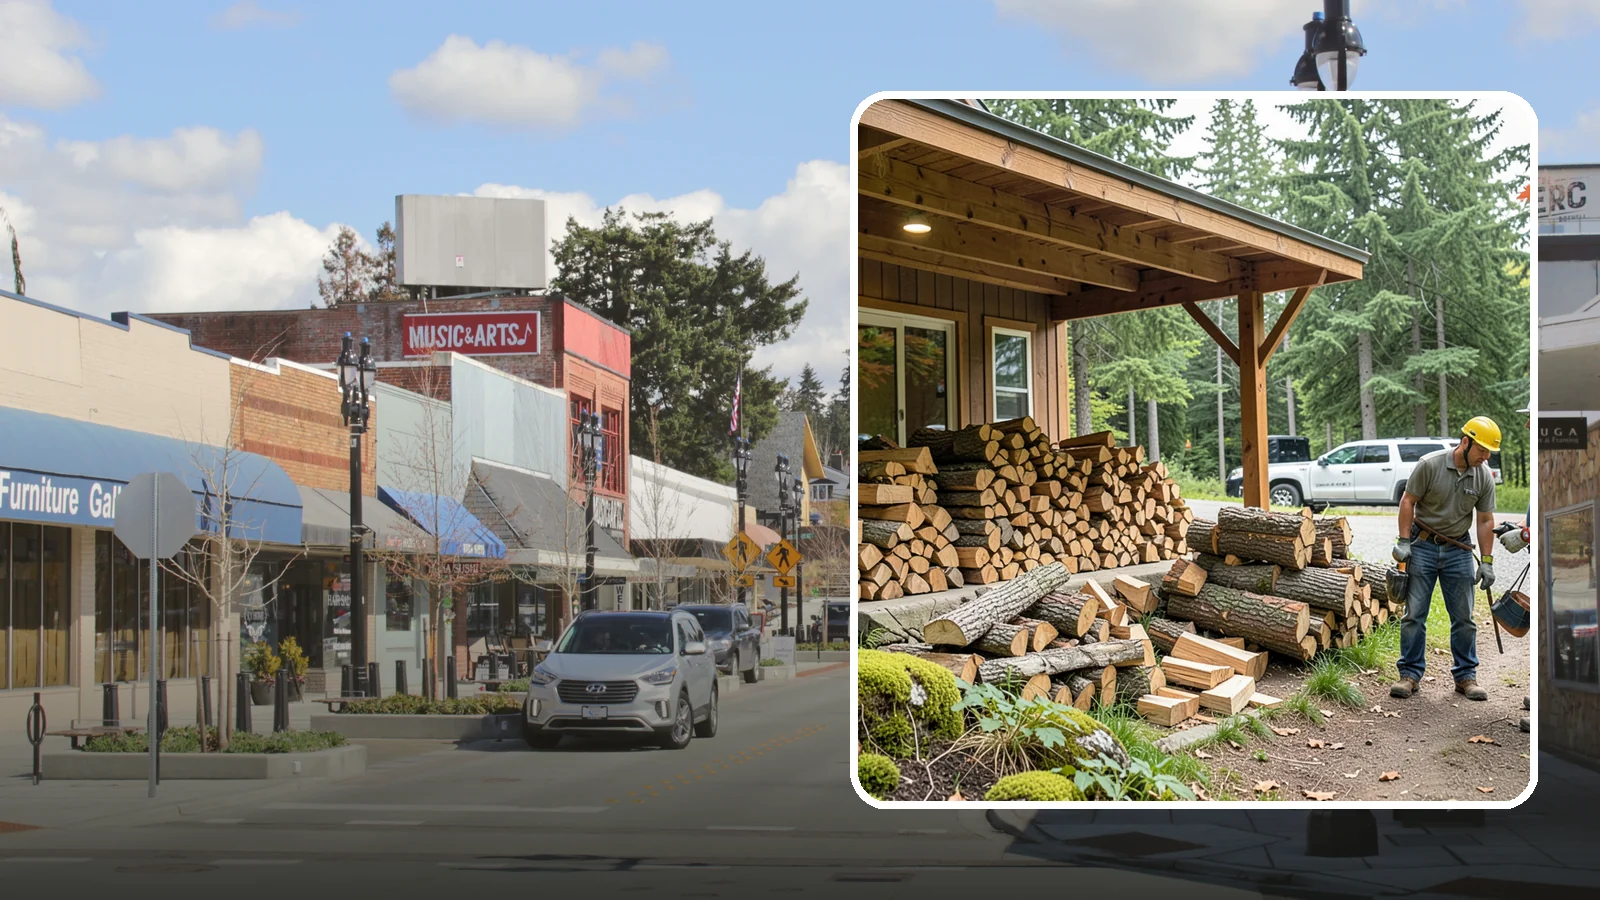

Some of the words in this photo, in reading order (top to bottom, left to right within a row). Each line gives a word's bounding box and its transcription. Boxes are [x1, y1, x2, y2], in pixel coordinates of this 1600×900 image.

[408, 323, 520, 349] MUSIC&ARTS
[0, 471, 80, 515] Furniture
[89, 482, 122, 519] Gal
